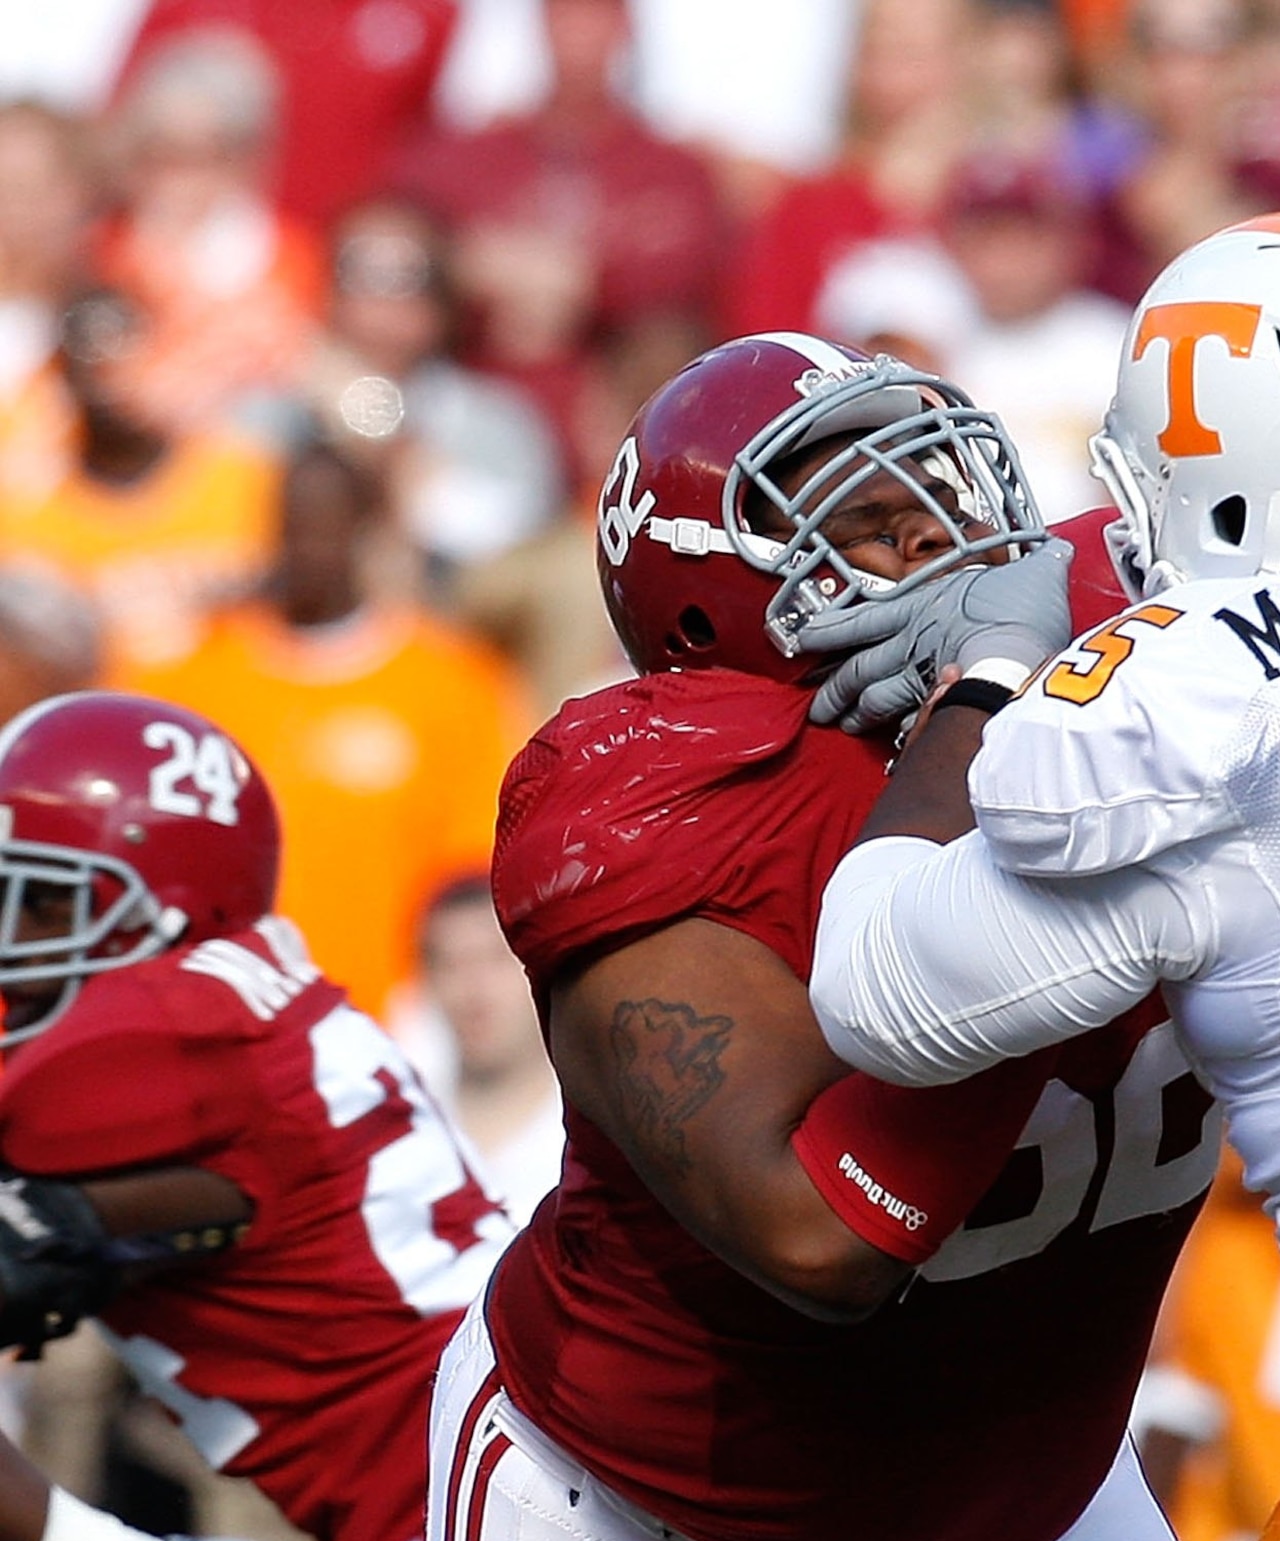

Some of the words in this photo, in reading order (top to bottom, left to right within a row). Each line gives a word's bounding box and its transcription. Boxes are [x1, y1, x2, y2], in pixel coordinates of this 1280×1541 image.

[1132, 301, 1262, 458] T
[1010, 603, 1187, 707] 5
[143, 720, 240, 827] 24
[838, 1152, 908, 1220] McDavid
